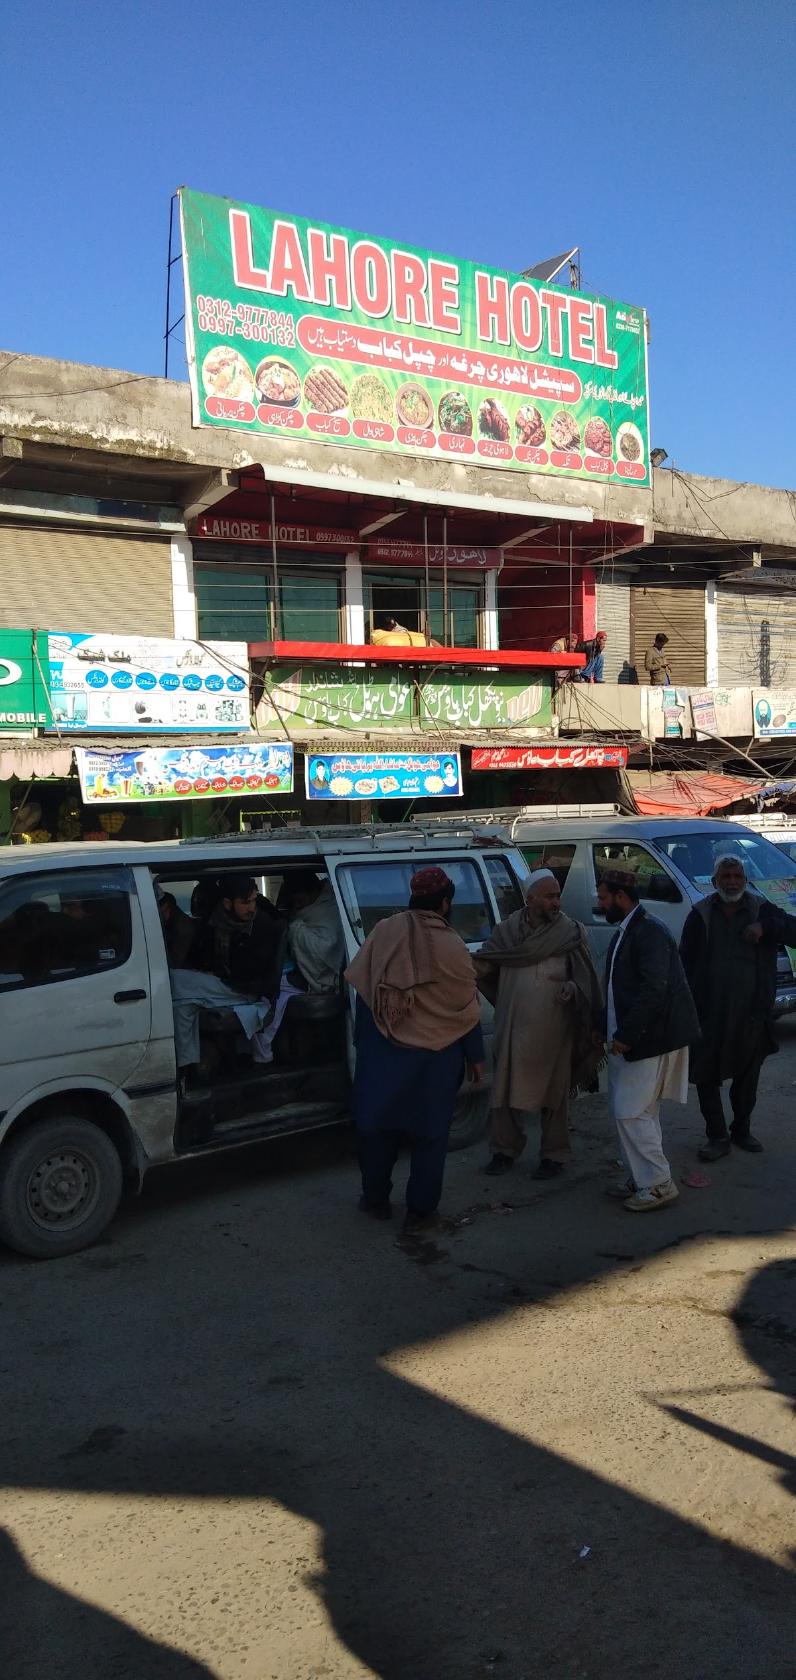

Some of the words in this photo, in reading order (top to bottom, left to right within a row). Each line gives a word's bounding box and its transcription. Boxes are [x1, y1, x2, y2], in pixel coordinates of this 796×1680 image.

[229, 208, 461, 334] LAHORE
[475, 271, 619, 369] HOTEL
[197, 295, 294, 329] 0312-9777844
[198, 313, 296, 348] 0997-300132
[307, 327, 324, 348] ہیں
[323, 330, 356, 352] دستیاب
[357, 337, 402, 361] کباب
[403, 341, 436, 372] چپل
[438, 354, 449, 367] اور
[203, 519, 260, 538] LAHORE
